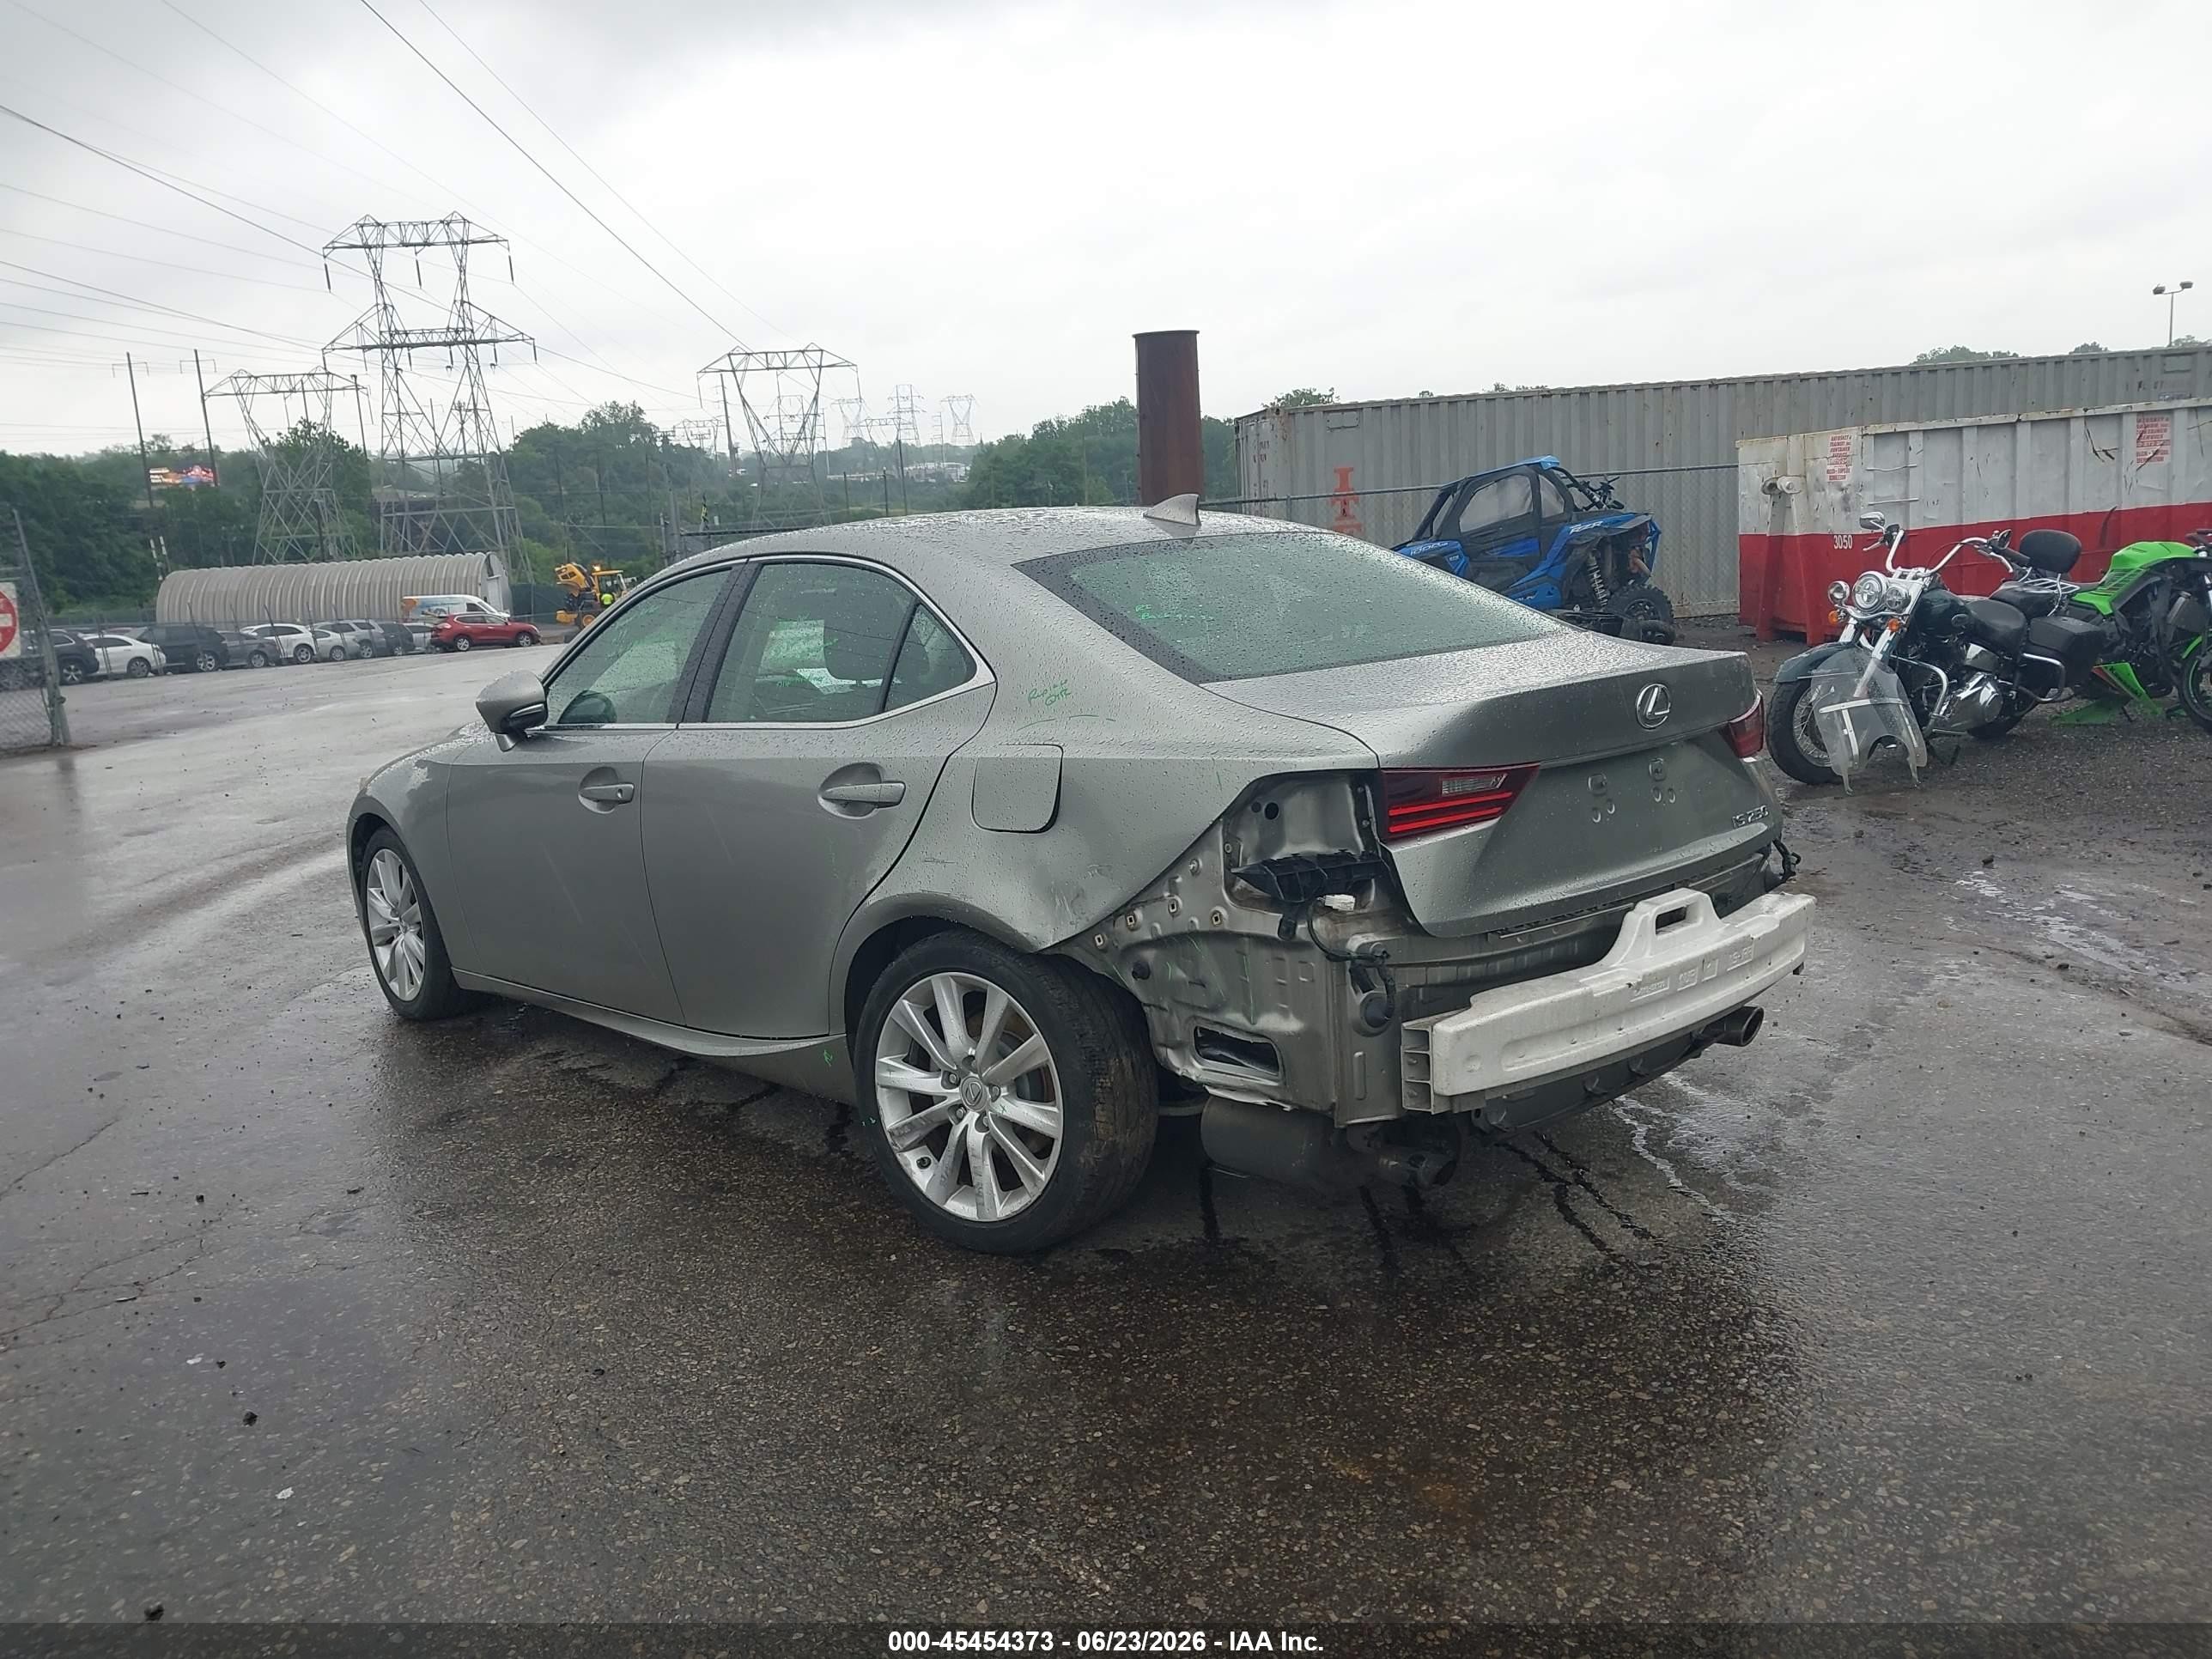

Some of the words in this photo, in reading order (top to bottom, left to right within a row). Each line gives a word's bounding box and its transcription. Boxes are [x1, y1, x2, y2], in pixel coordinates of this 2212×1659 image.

[1833, 534, 1853, 550] 3050
[1731, 813, 1746, 829] IS
[1747, 805, 1769, 823] 250
